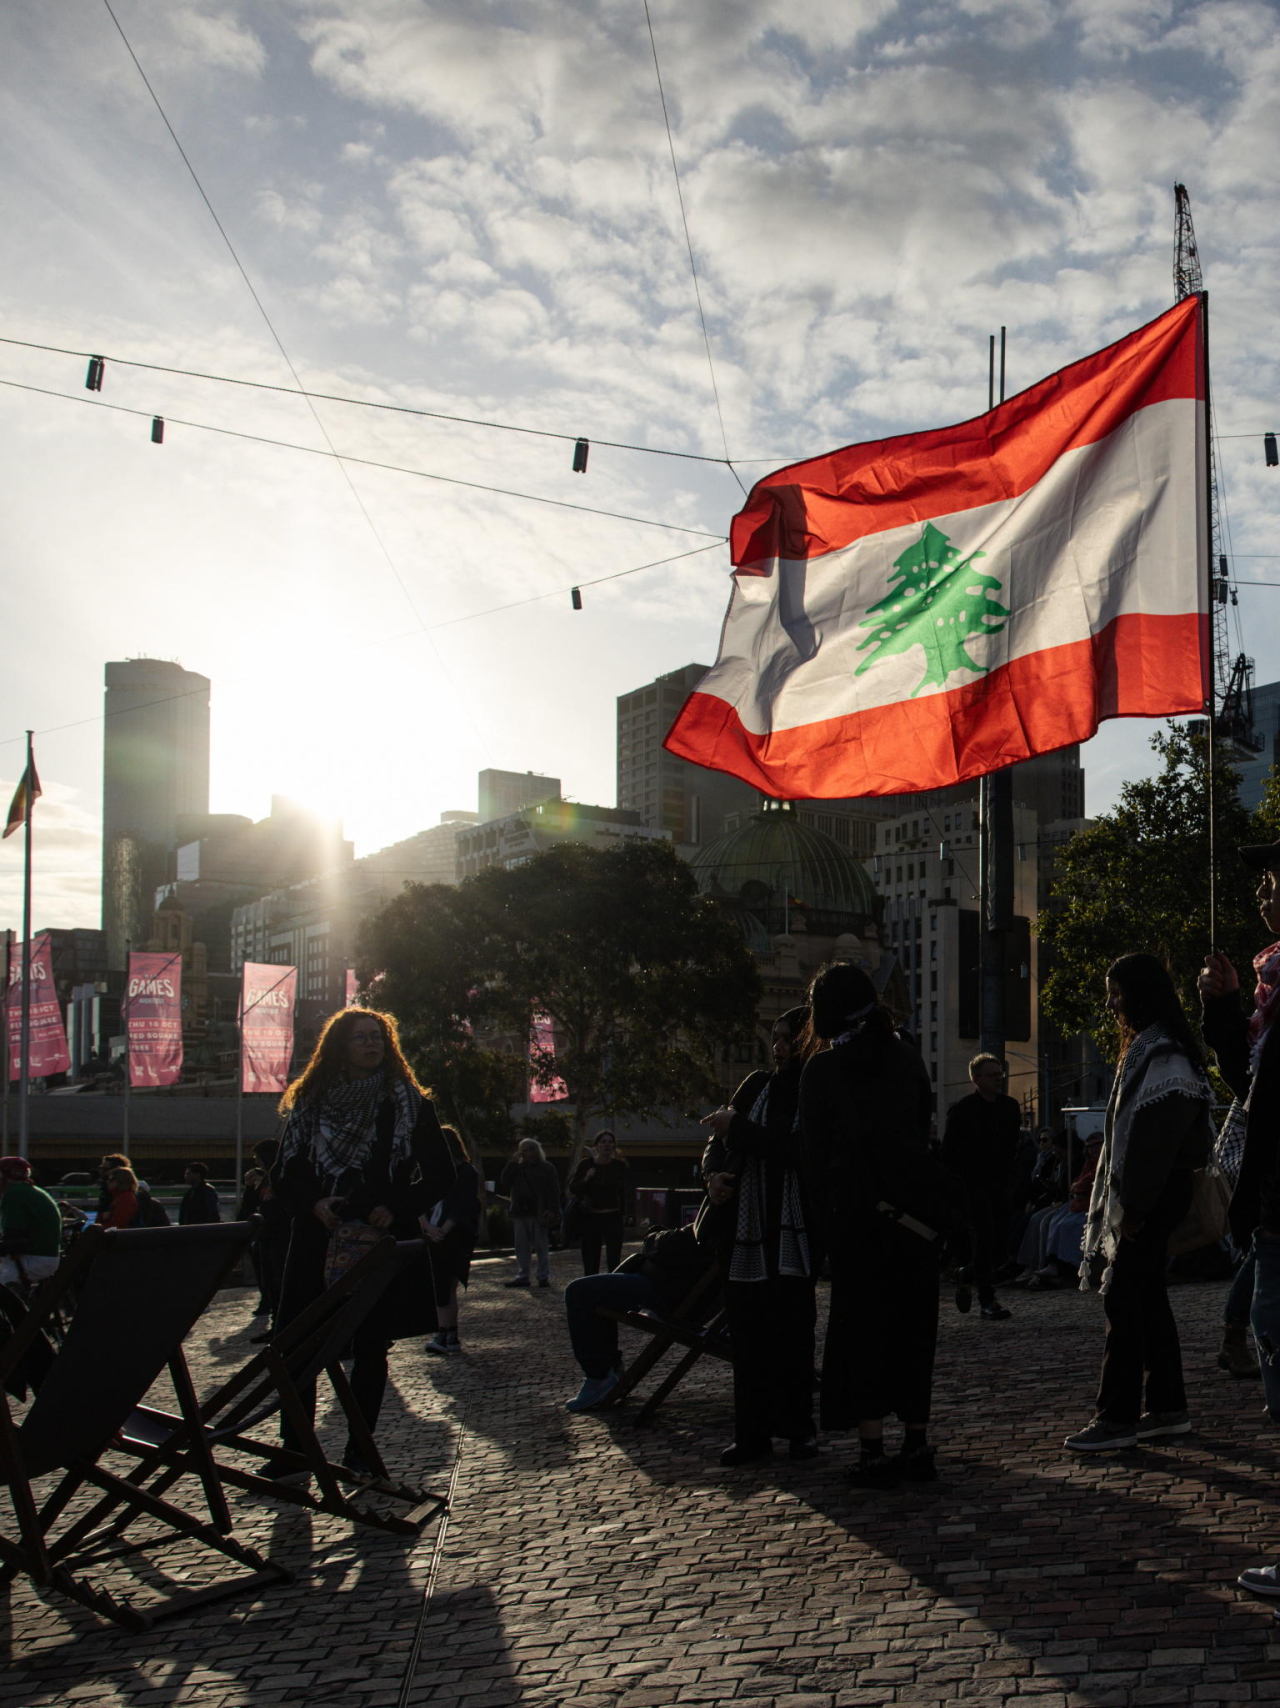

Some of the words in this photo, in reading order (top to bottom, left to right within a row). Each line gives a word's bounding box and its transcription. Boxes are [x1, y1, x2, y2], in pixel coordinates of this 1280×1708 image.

[128, 978, 175, 998] GAMES
[245, 988, 290, 1008] GAMES
[147, 1032, 180, 1040] SQUARE
